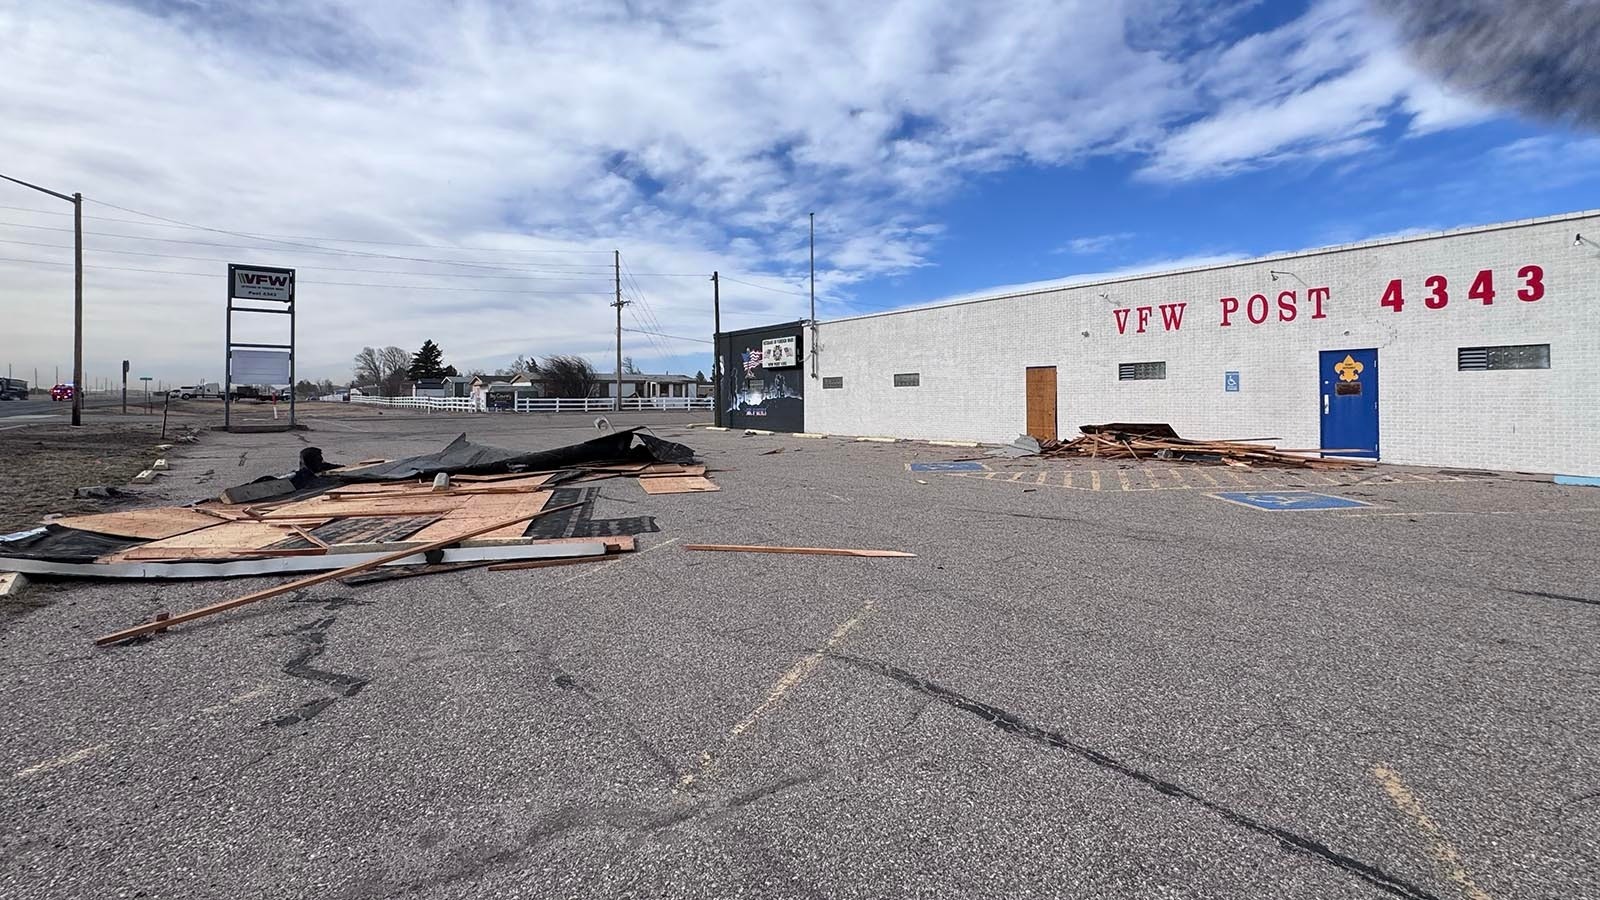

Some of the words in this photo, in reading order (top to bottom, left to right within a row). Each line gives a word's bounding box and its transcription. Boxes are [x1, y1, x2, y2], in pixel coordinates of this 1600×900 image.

[244, 273, 288, 286] VFW
[1113, 302, 1187, 335] VFW
[1220, 287, 1330, 327] POST
[1380, 264, 1545, 313] 4343
